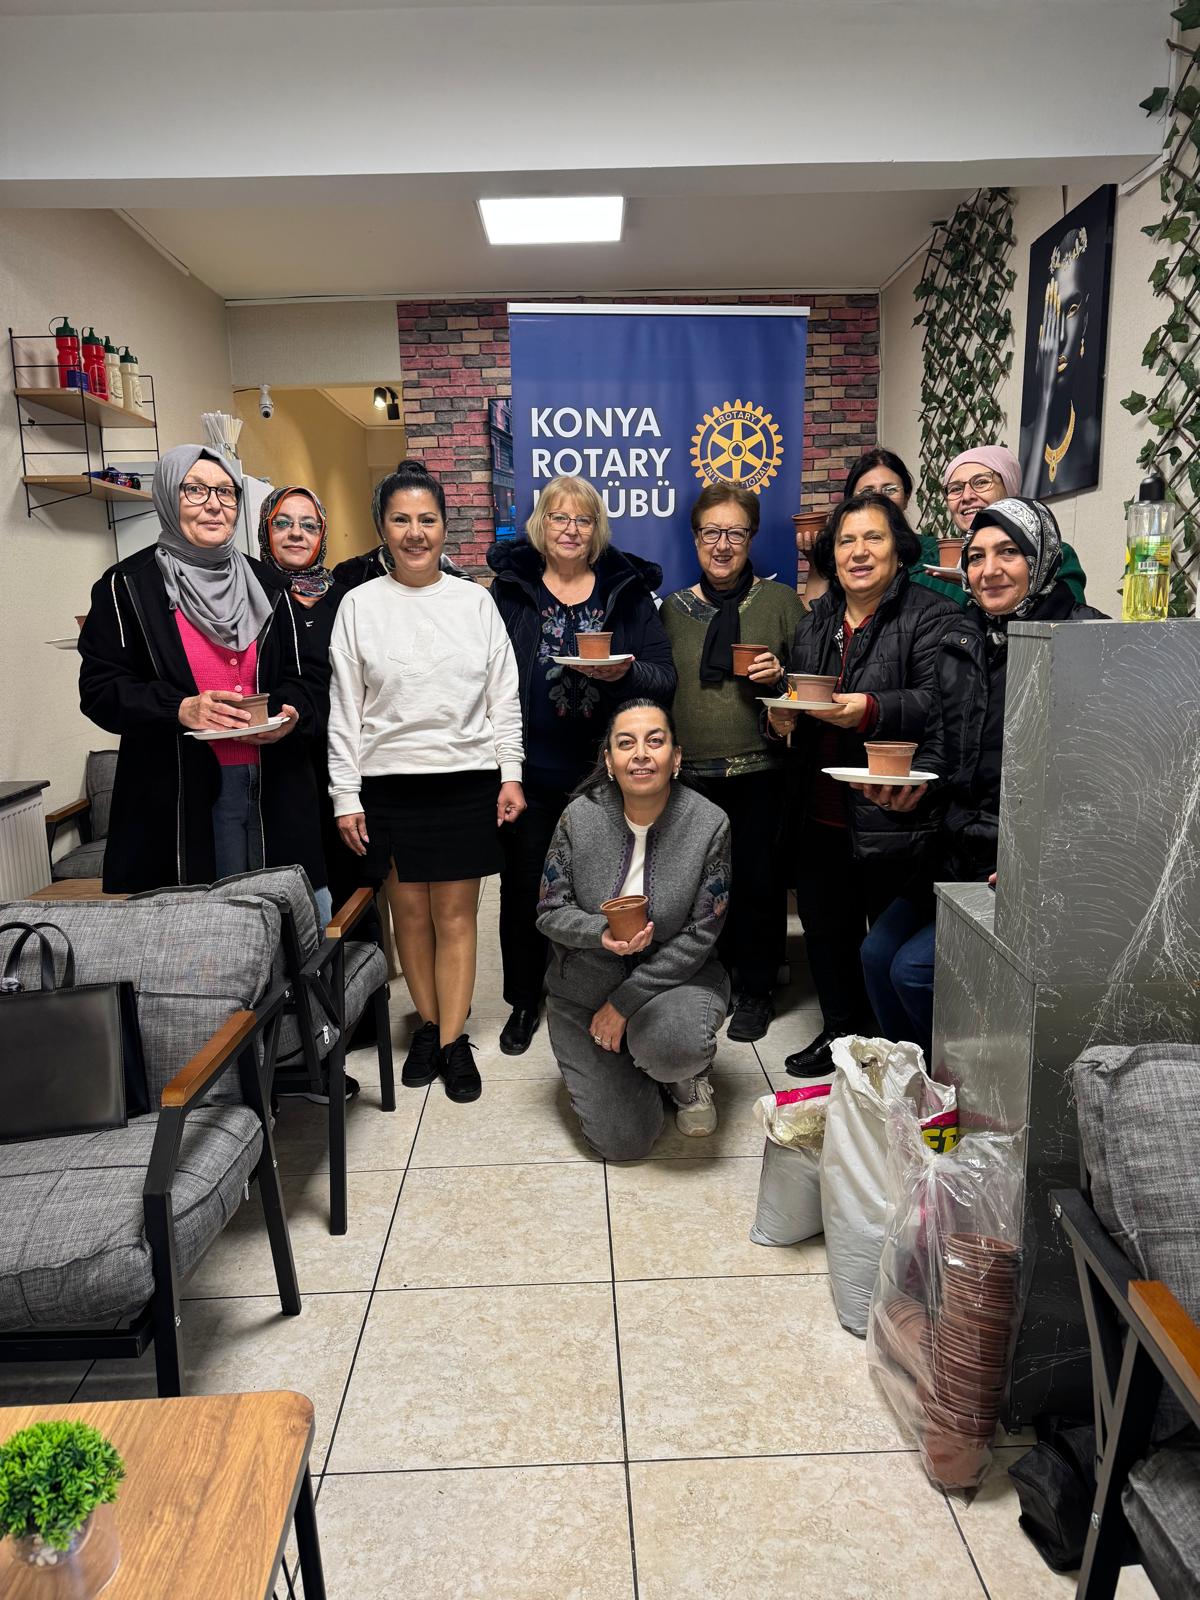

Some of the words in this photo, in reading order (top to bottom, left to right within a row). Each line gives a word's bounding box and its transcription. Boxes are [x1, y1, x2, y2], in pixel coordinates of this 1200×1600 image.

[531, 407, 661, 437] KONYA
[718, 411, 758, 424] ROTARY
[532, 448, 671, 478] ROTARY
[533, 480, 675, 518] ÜBÜ
